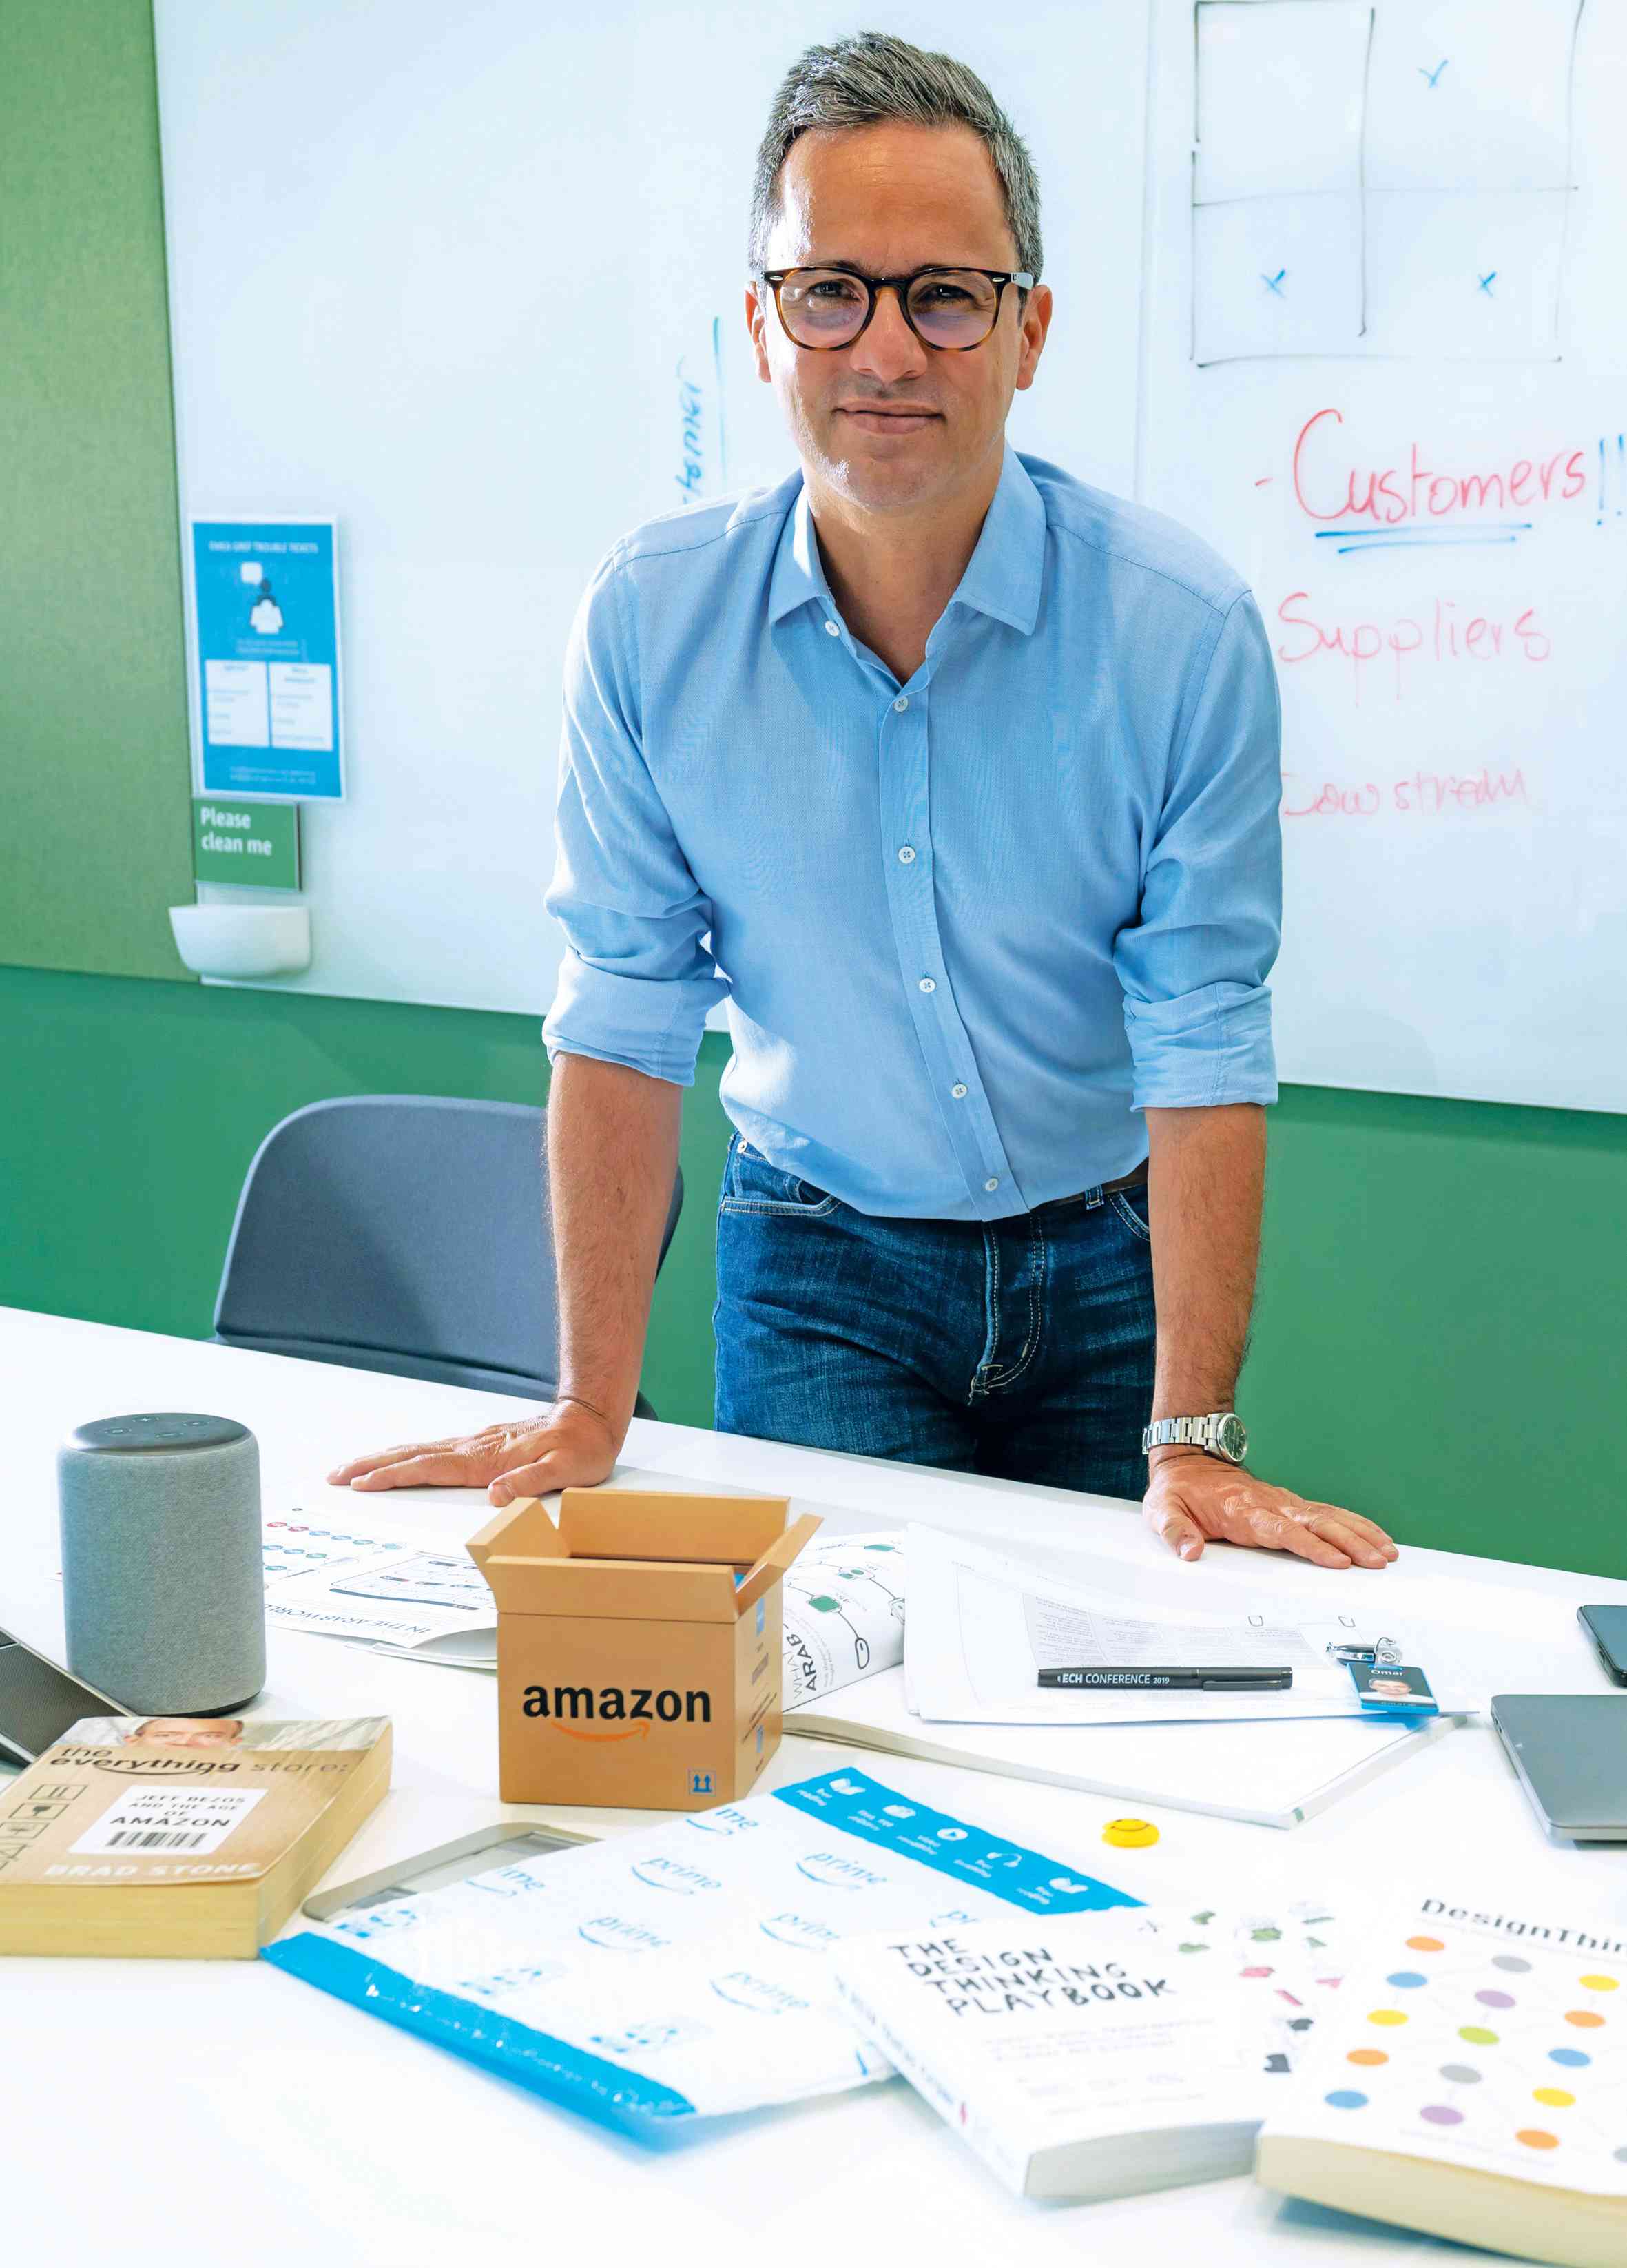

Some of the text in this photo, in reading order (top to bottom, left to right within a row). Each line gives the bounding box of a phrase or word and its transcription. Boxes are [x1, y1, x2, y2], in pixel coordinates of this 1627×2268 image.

[1278, 592, 1551, 708] Suppliers
[200, 807, 251, 829] Please
[201, 831, 273, 856] clean me
[786, 1633, 817, 1691] ARAB
[1057, 1673, 1170, 1684] ECH CONFERENCE 2019
[522, 1684, 712, 1723] amazon
[61, 1747, 113, 1758] the
[50, 1757, 241, 1776] everything
[109, 1816, 232, 1827] AMAZON
[45, 1862, 262, 1877] BRAD STONE
[804, 1853, 888, 1883] prime
[887, 1938, 968, 1959] THE
[907, 1948, 1053, 1977] DESIGN
[924, 1962, 1128, 1994] THINKING
[946, 1978, 1176, 2017] PLAYBOOK
